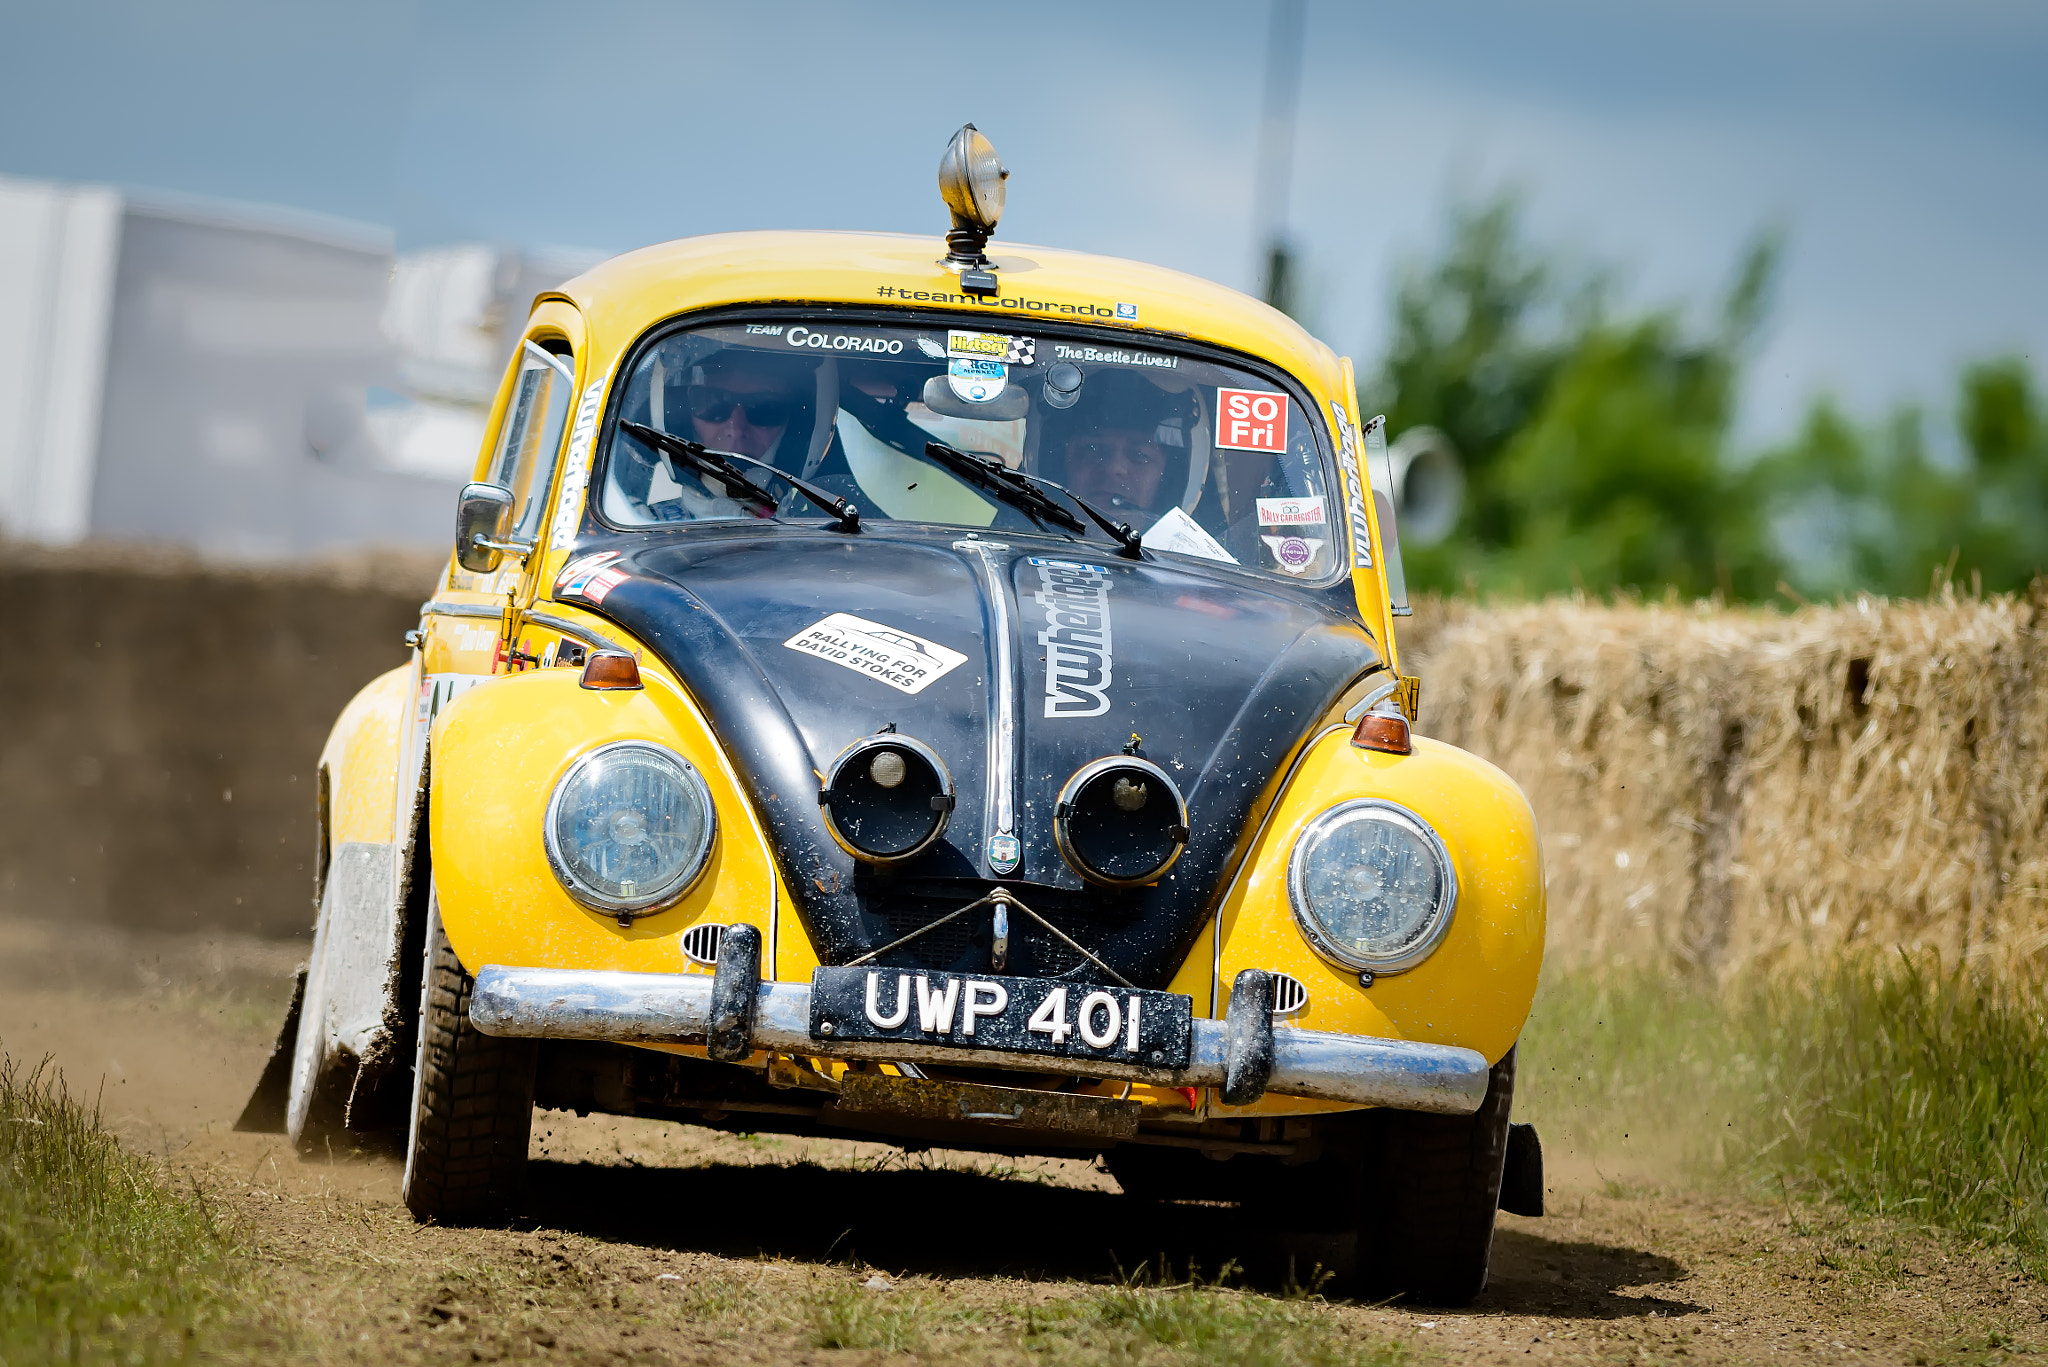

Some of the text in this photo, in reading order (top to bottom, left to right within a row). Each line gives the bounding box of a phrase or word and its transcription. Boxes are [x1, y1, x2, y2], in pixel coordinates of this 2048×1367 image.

[877, 285, 1113, 318] #teamColorado
[745, 324, 904, 355] TEAM COLORADO
[950, 335, 1008, 357] History
[1055, 345, 1178, 369] The Beetle Lives!
[1227, 395, 1278, 421] SO
[1230, 420, 1274, 447] Fri
[1331, 401, 1373, 568] vwheritage
[1261, 506, 1322, 522] RALLY CAR REGISTER
[808, 631, 928, 679] RALLYING FOR
[1039, 566, 1111, 717] vwheritage
[795, 639, 915, 687] DAVID STOKES
[864, 972, 1142, 1053] UWP 401
